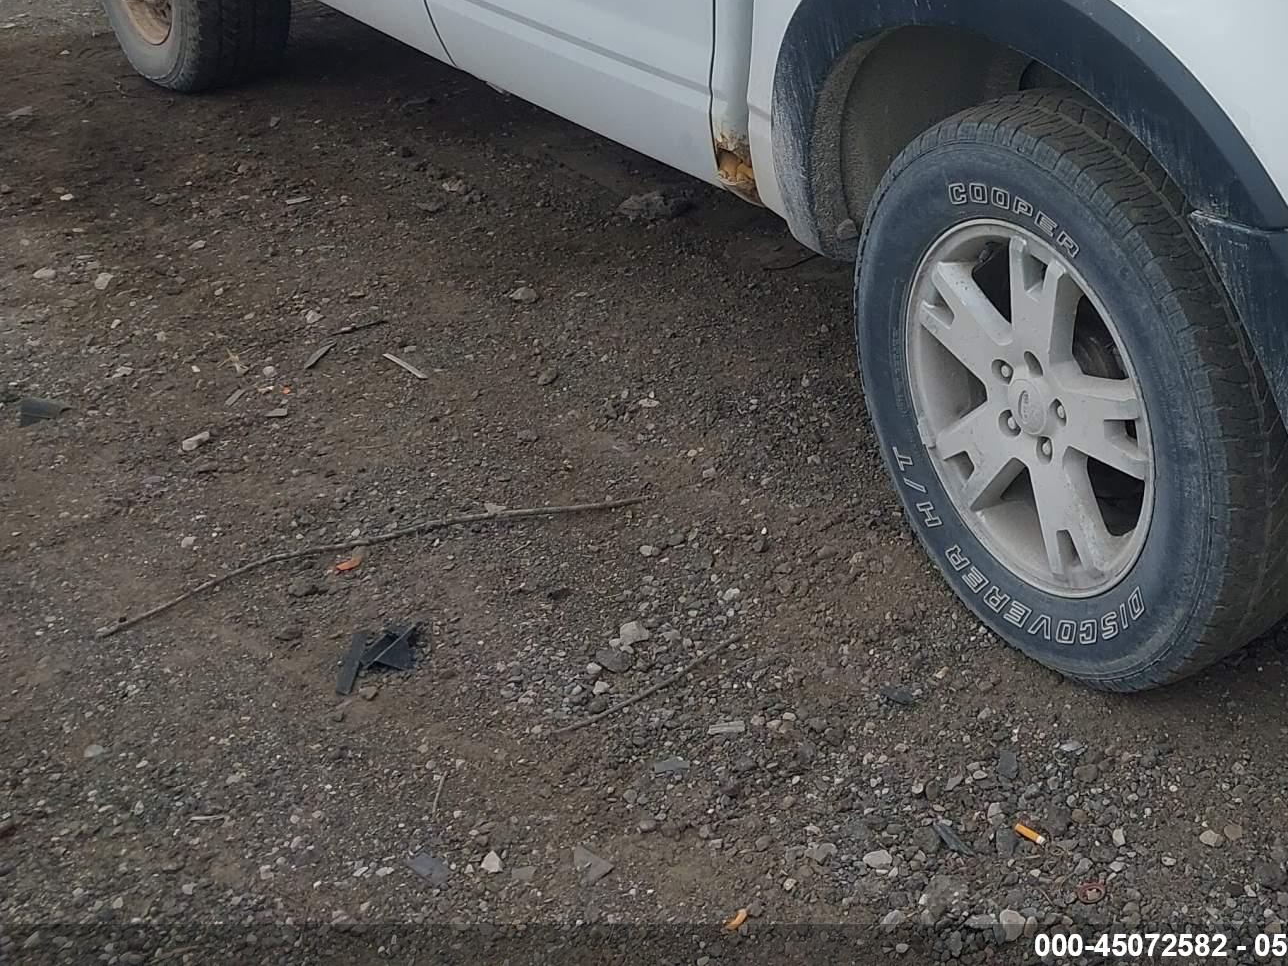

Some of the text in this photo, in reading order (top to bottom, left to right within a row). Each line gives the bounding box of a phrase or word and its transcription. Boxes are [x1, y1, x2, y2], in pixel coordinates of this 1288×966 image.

[948, 182, 1080, 258] COOPER
[892, 446, 1146, 645] DISCOVERER H/T
